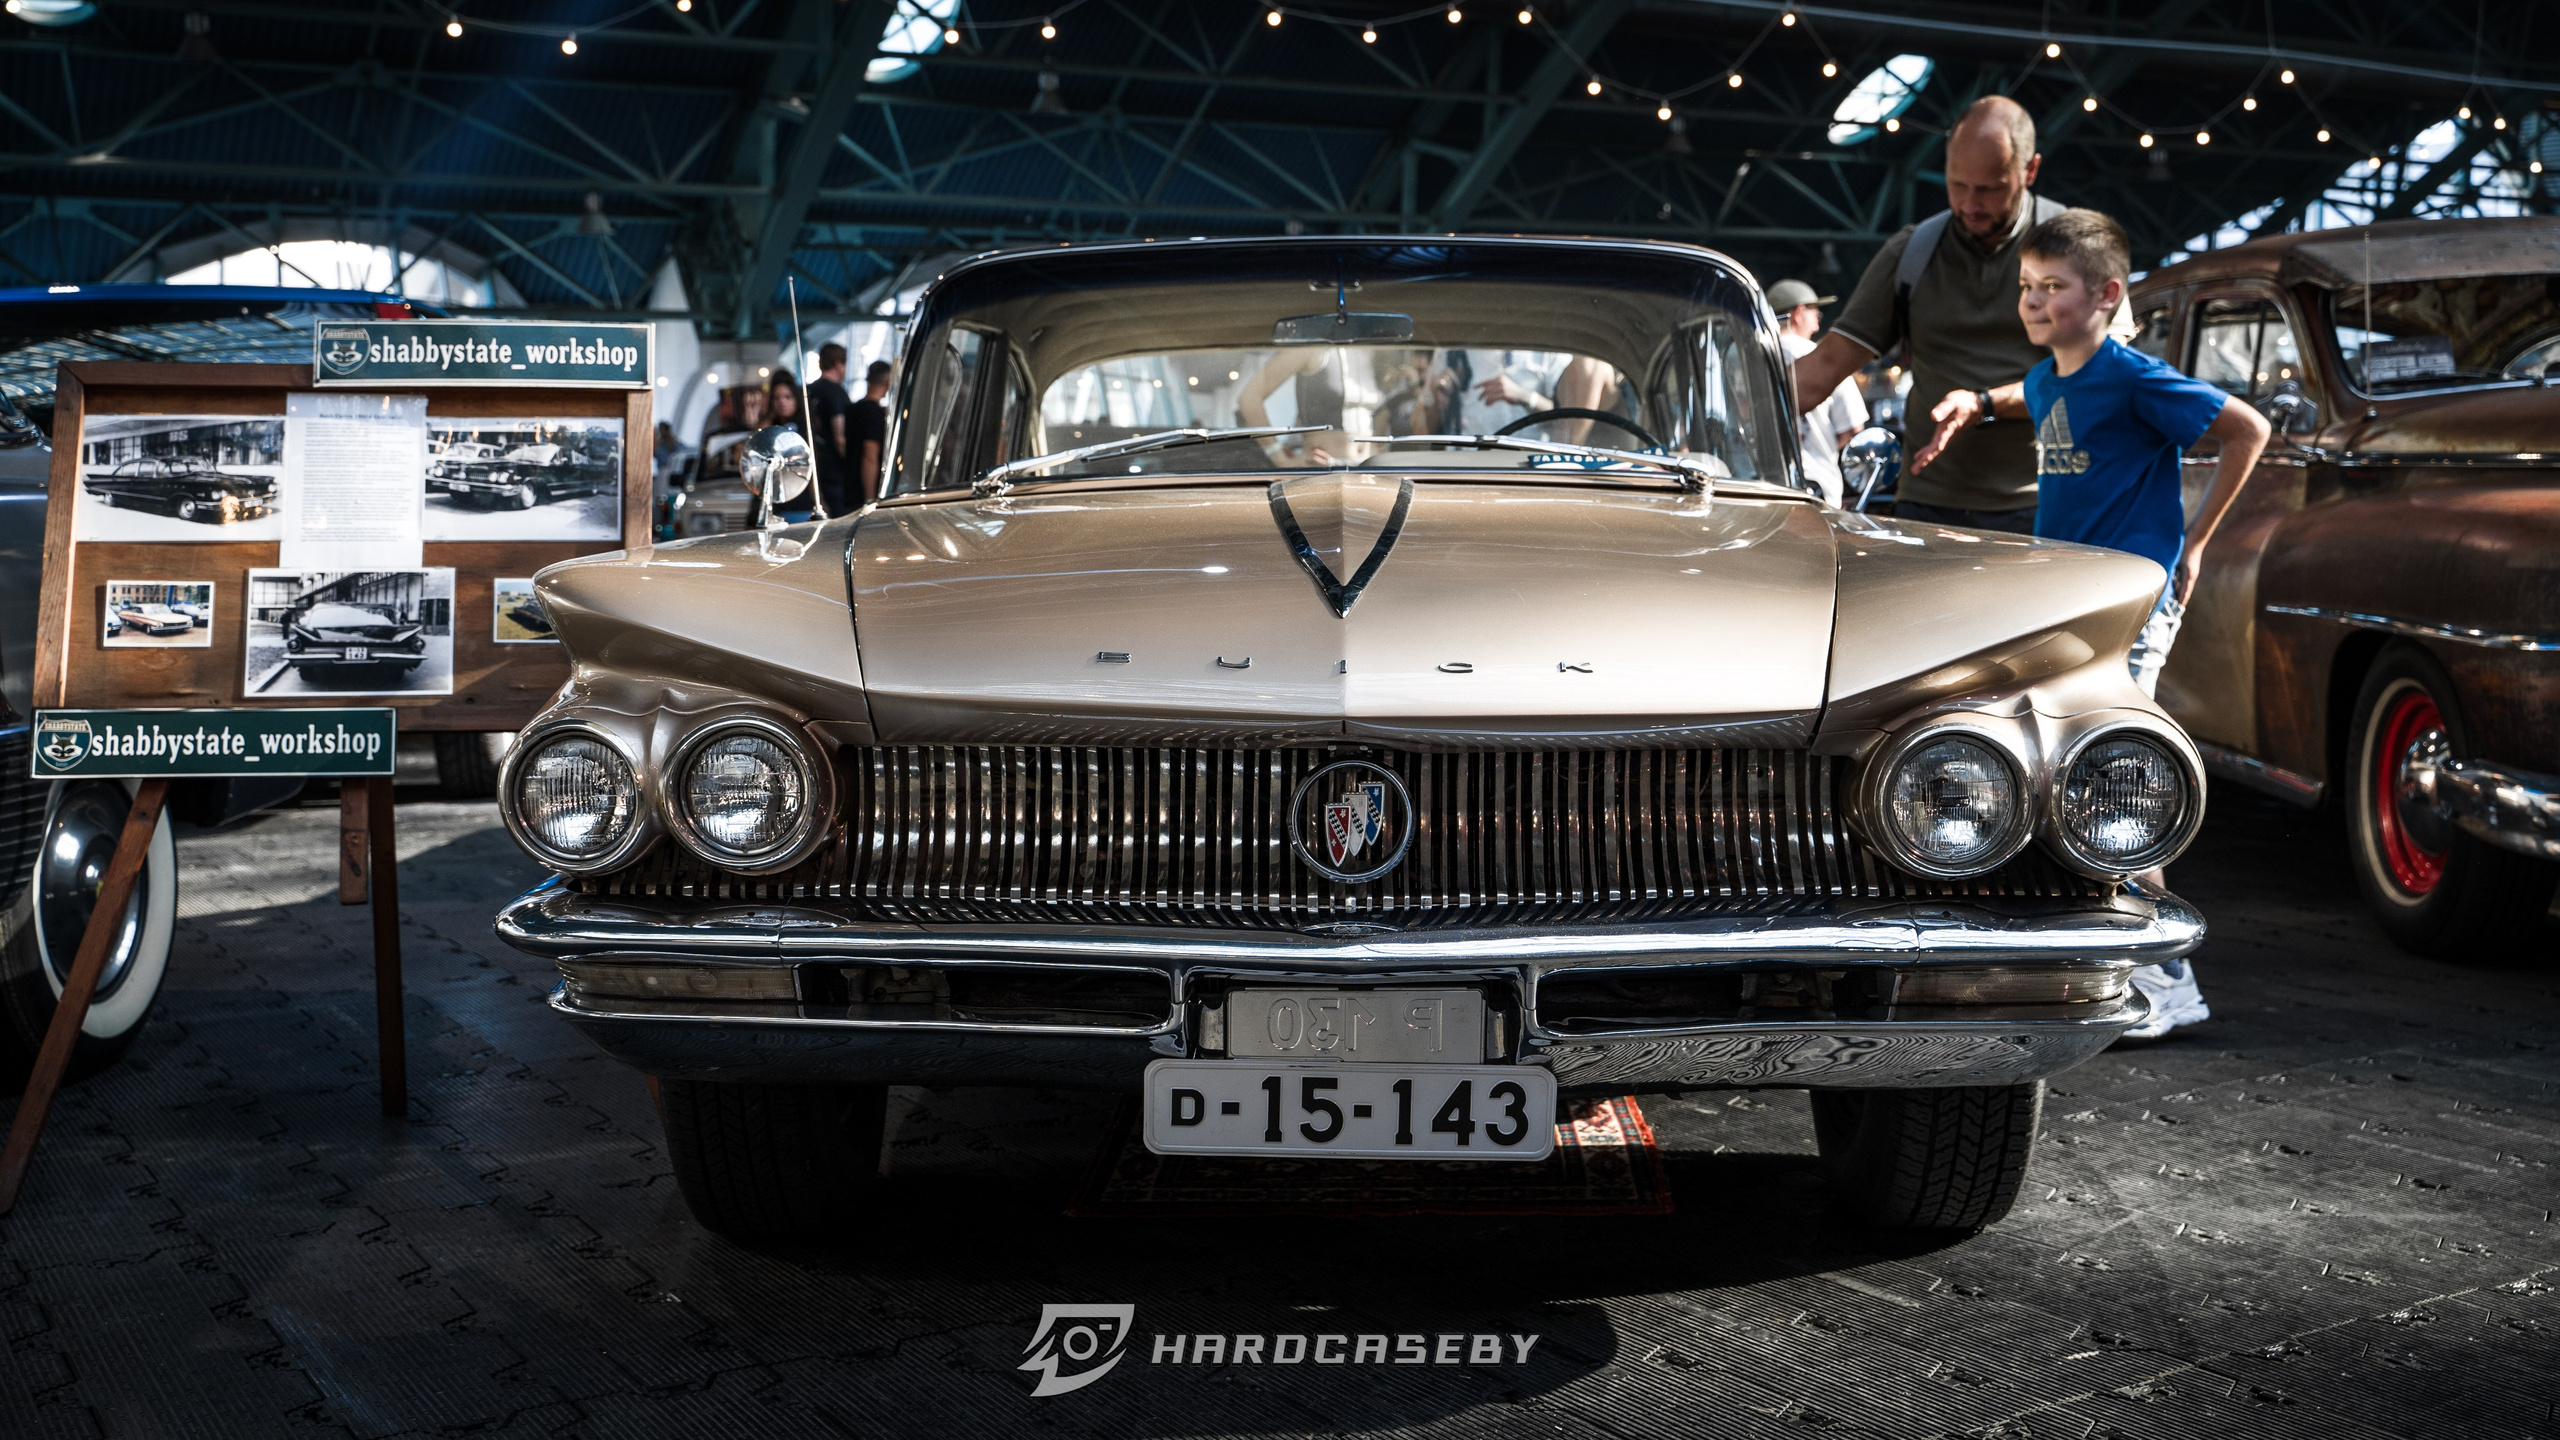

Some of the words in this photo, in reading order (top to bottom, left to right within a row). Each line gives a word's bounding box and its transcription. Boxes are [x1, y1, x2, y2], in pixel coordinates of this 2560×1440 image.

[369, 335, 638, 371] shabbystate_workshop
[1097, 651, 1594, 673] BUICK
[91, 724, 381, 764] shabbystate_workshop
[1170, 1075, 1530, 1146] D-15-143
